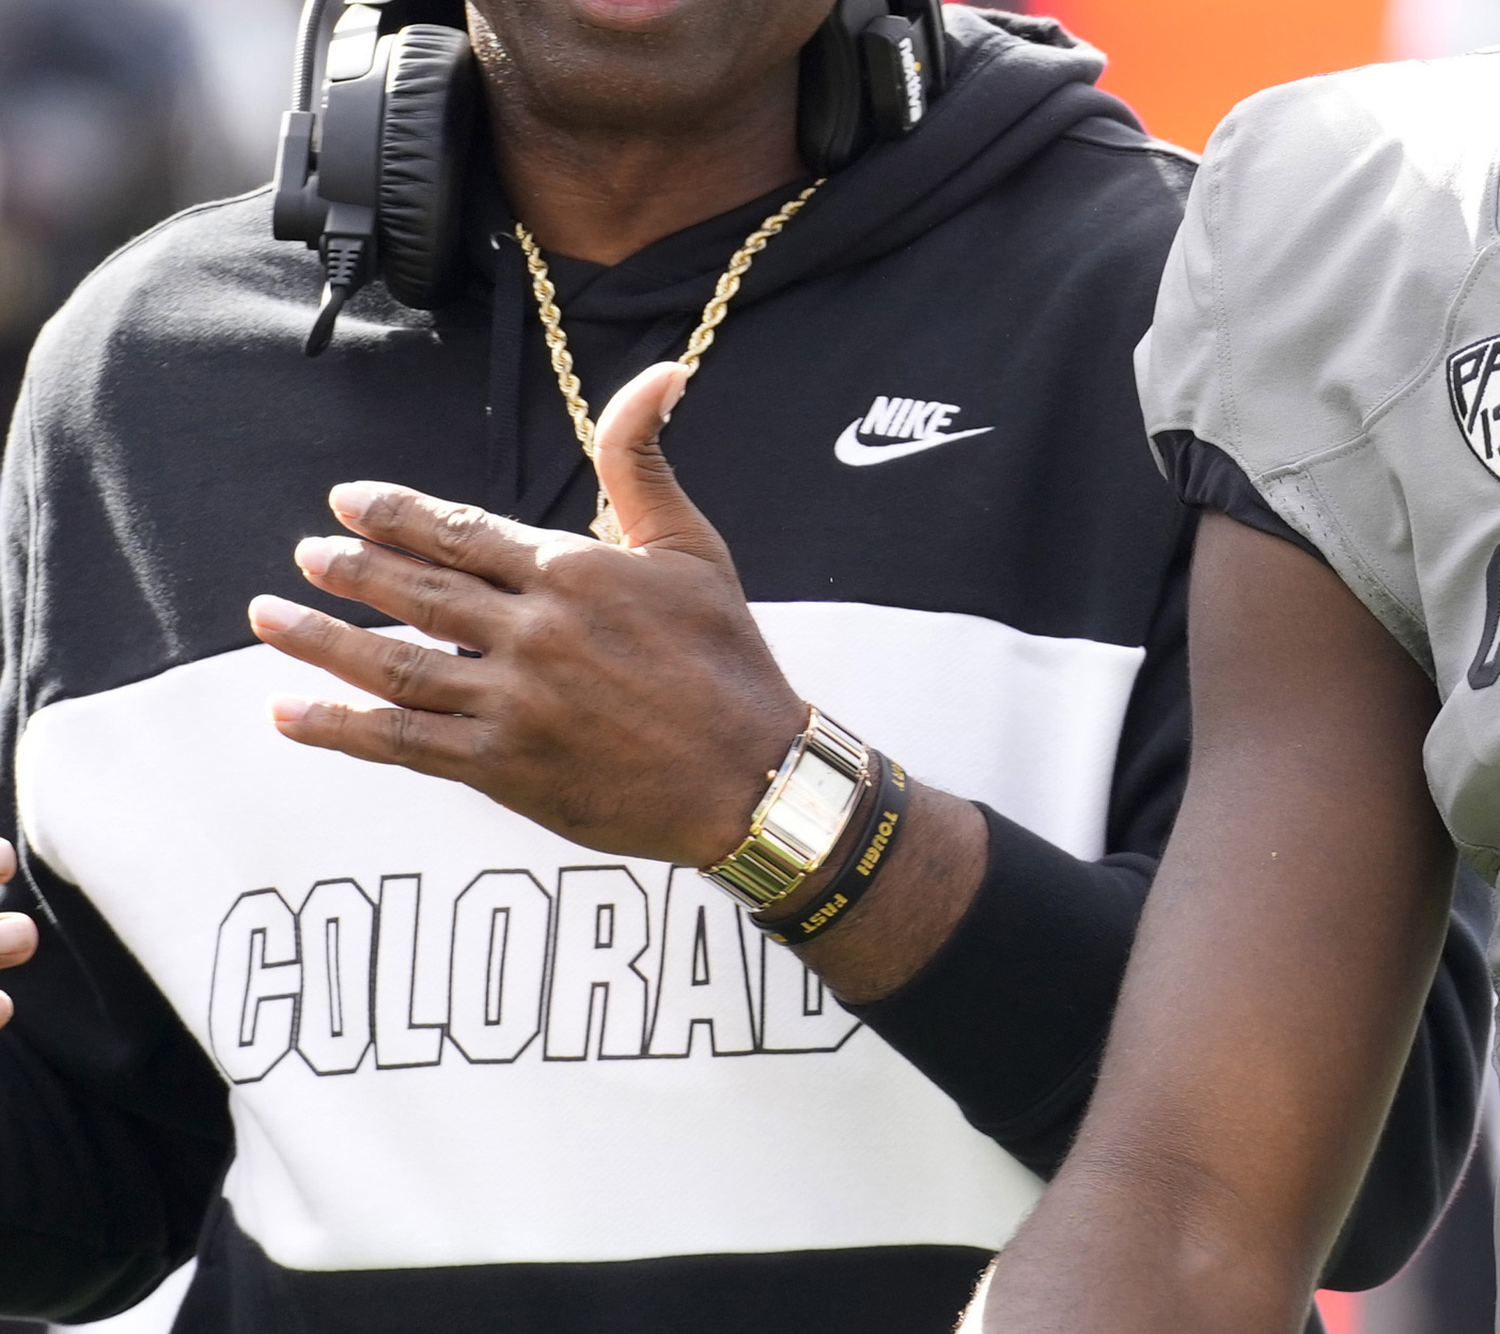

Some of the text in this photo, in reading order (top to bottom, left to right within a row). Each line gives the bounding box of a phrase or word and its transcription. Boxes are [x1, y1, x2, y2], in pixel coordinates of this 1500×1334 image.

[859, 395, 962, 441] NIKE
[800, 810, 899, 934] TOUGH FAST
[209, 866, 866, 1086] COLORAD
